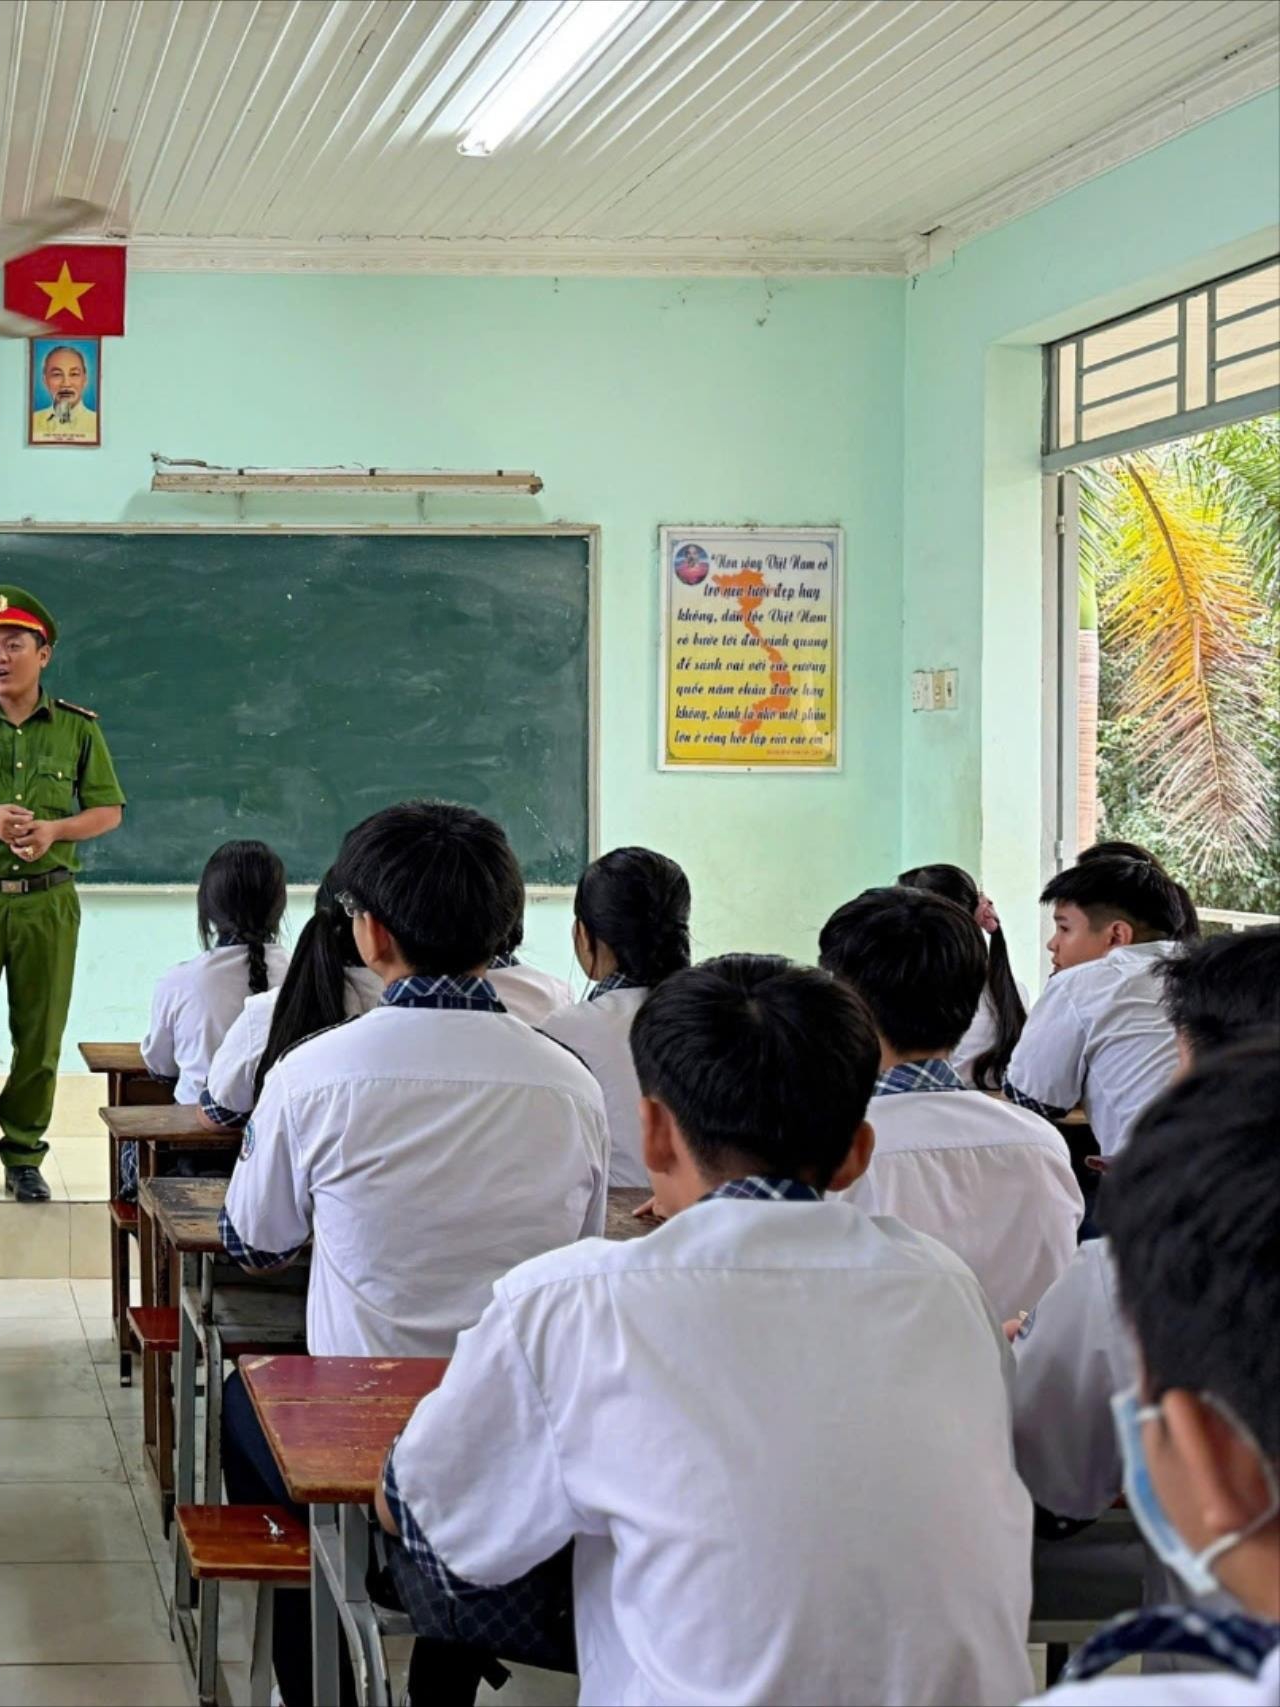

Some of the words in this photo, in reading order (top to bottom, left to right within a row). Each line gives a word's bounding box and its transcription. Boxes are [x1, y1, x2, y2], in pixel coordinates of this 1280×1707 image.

[798, 583, 821, 600] hay
[768, 610, 793, 625] Việt
[797, 610, 827, 623] Nam
